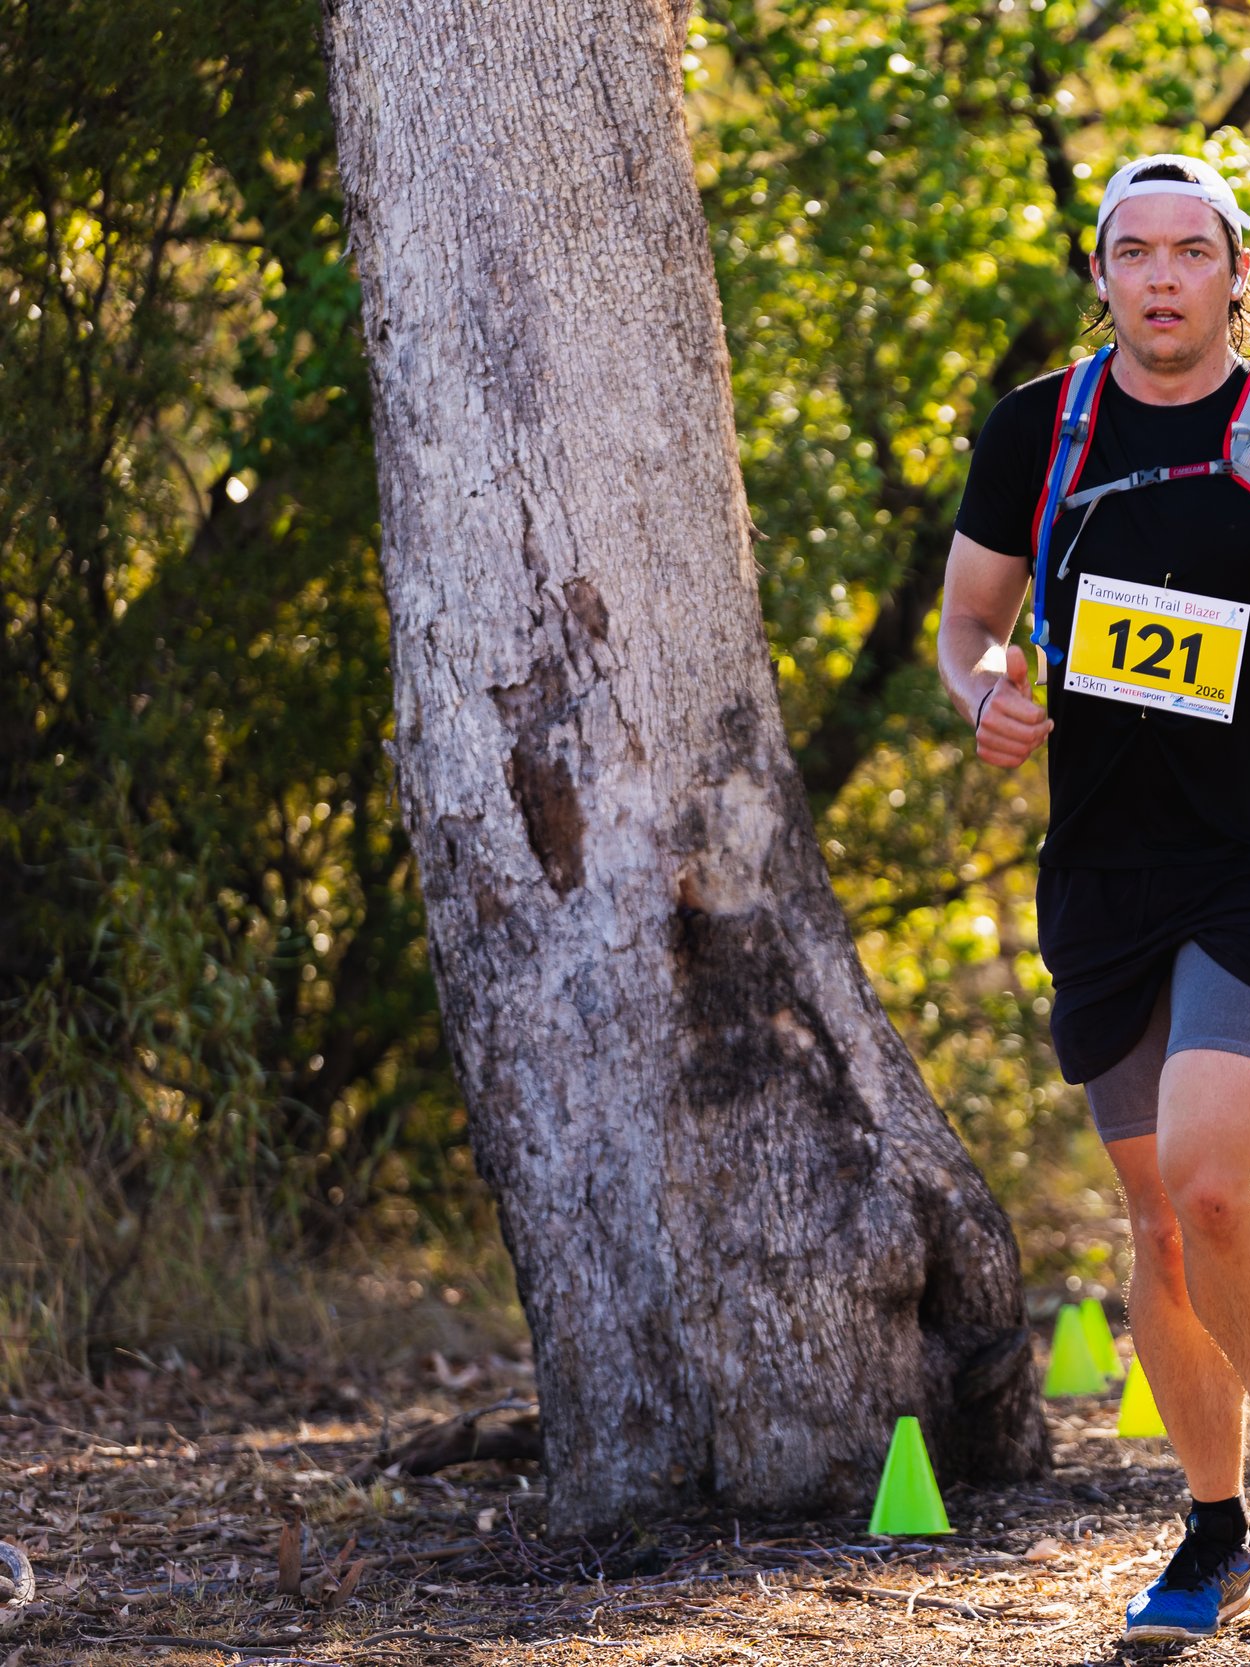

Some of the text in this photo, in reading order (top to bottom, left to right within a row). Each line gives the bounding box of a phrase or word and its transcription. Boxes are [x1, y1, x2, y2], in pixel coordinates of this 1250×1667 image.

[1090, 583, 1221, 620] Tamworth Trail Blazer
[1108, 618, 1203, 685] 121
[1075, 675, 1107, 693] 15km
[1195, 684, 1225, 700] 2026
[1119, 688, 1166, 702] INTERSPORT
